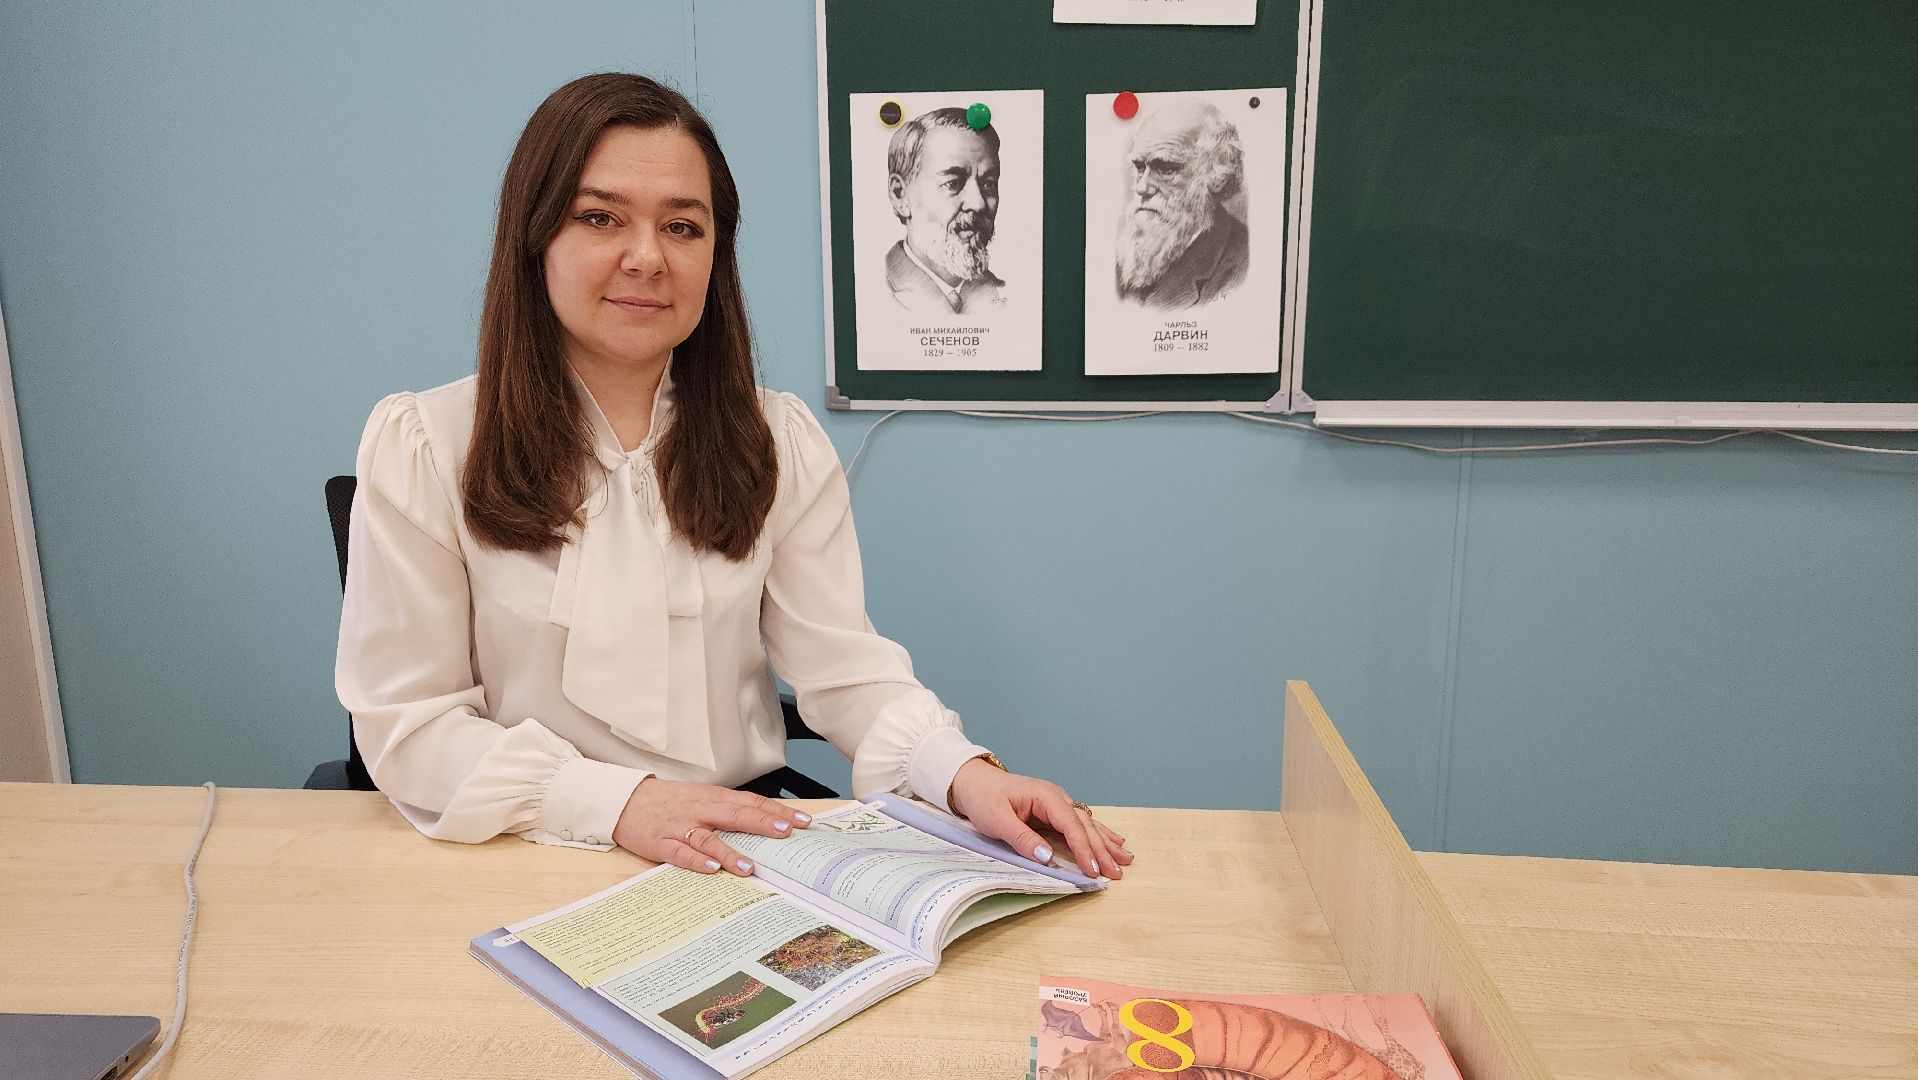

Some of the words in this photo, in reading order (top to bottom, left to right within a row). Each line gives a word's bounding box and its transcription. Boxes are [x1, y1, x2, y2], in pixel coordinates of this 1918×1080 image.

[910, 327, 931, 335] ИВАН
[933, 326, 990, 335] МИХАЙЛОВИЧ
[1153, 329, 1208, 342] ДАРВИН
[920, 336, 980, 346] СЕЧЕНОВ
[1154, 343, 1174, 352] 1809
[1188, 342, 1209, 351] 1882
[924, 348, 944, 357] 1829
[1119, 998, 1196, 1073] 8
